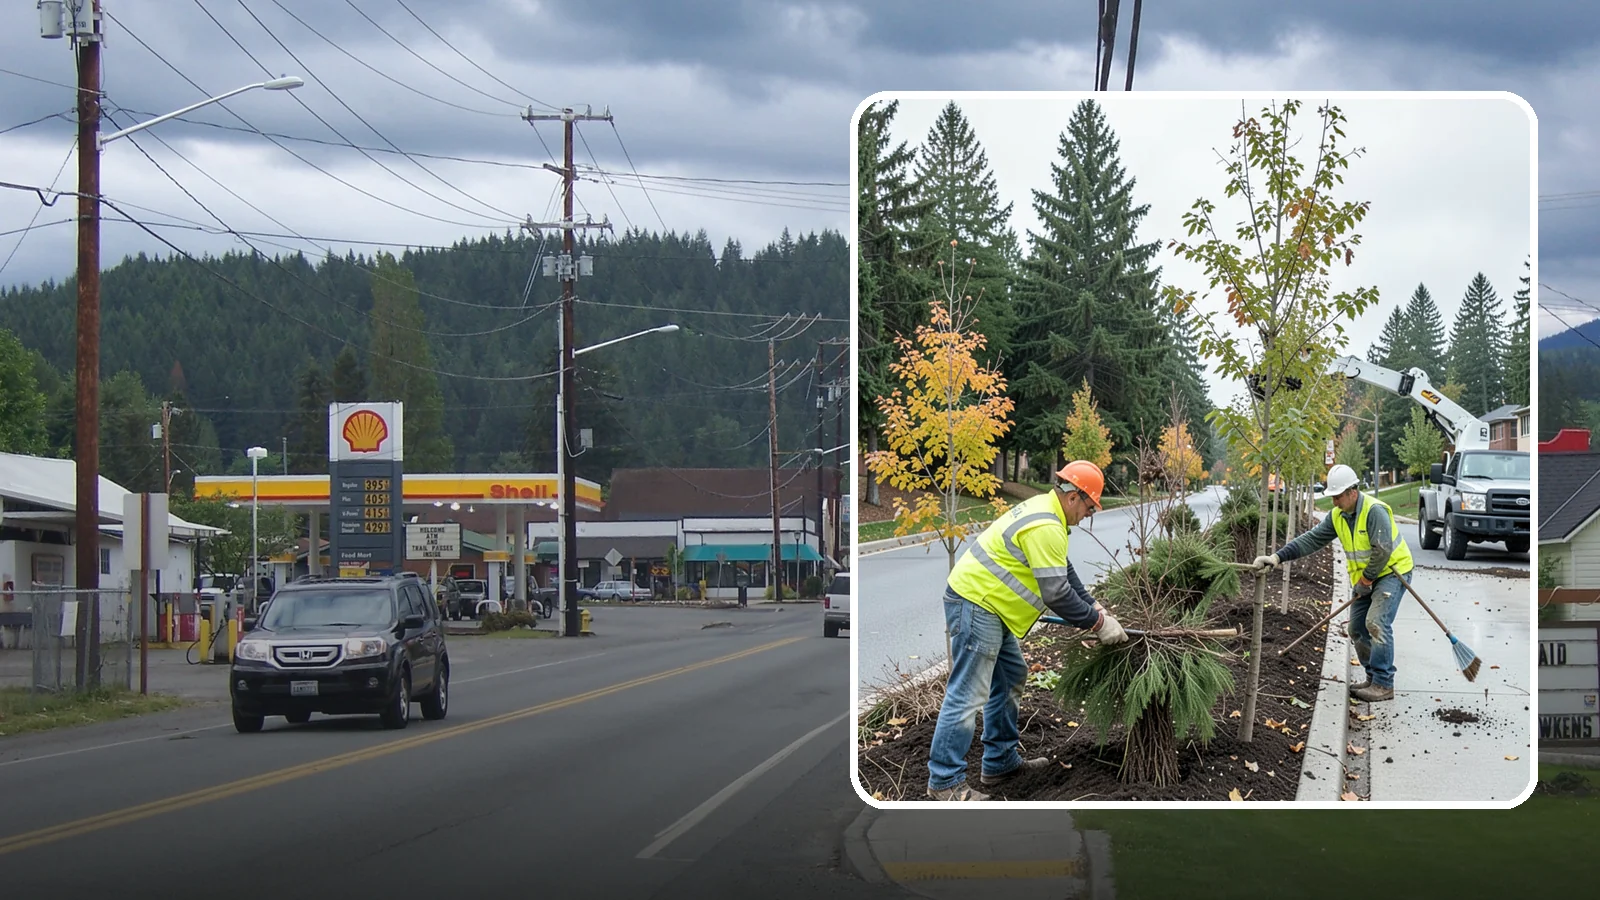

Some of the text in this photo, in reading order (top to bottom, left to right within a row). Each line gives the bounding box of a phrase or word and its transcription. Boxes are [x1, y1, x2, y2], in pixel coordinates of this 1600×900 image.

[365, 480, 383, 490] 395
[490, 484, 547, 499] Shell
[365, 494, 383, 504] 405
[365, 507, 383, 518] 415
[365, 522, 383, 532] 429
[1538, 642, 1567, 666] AID
